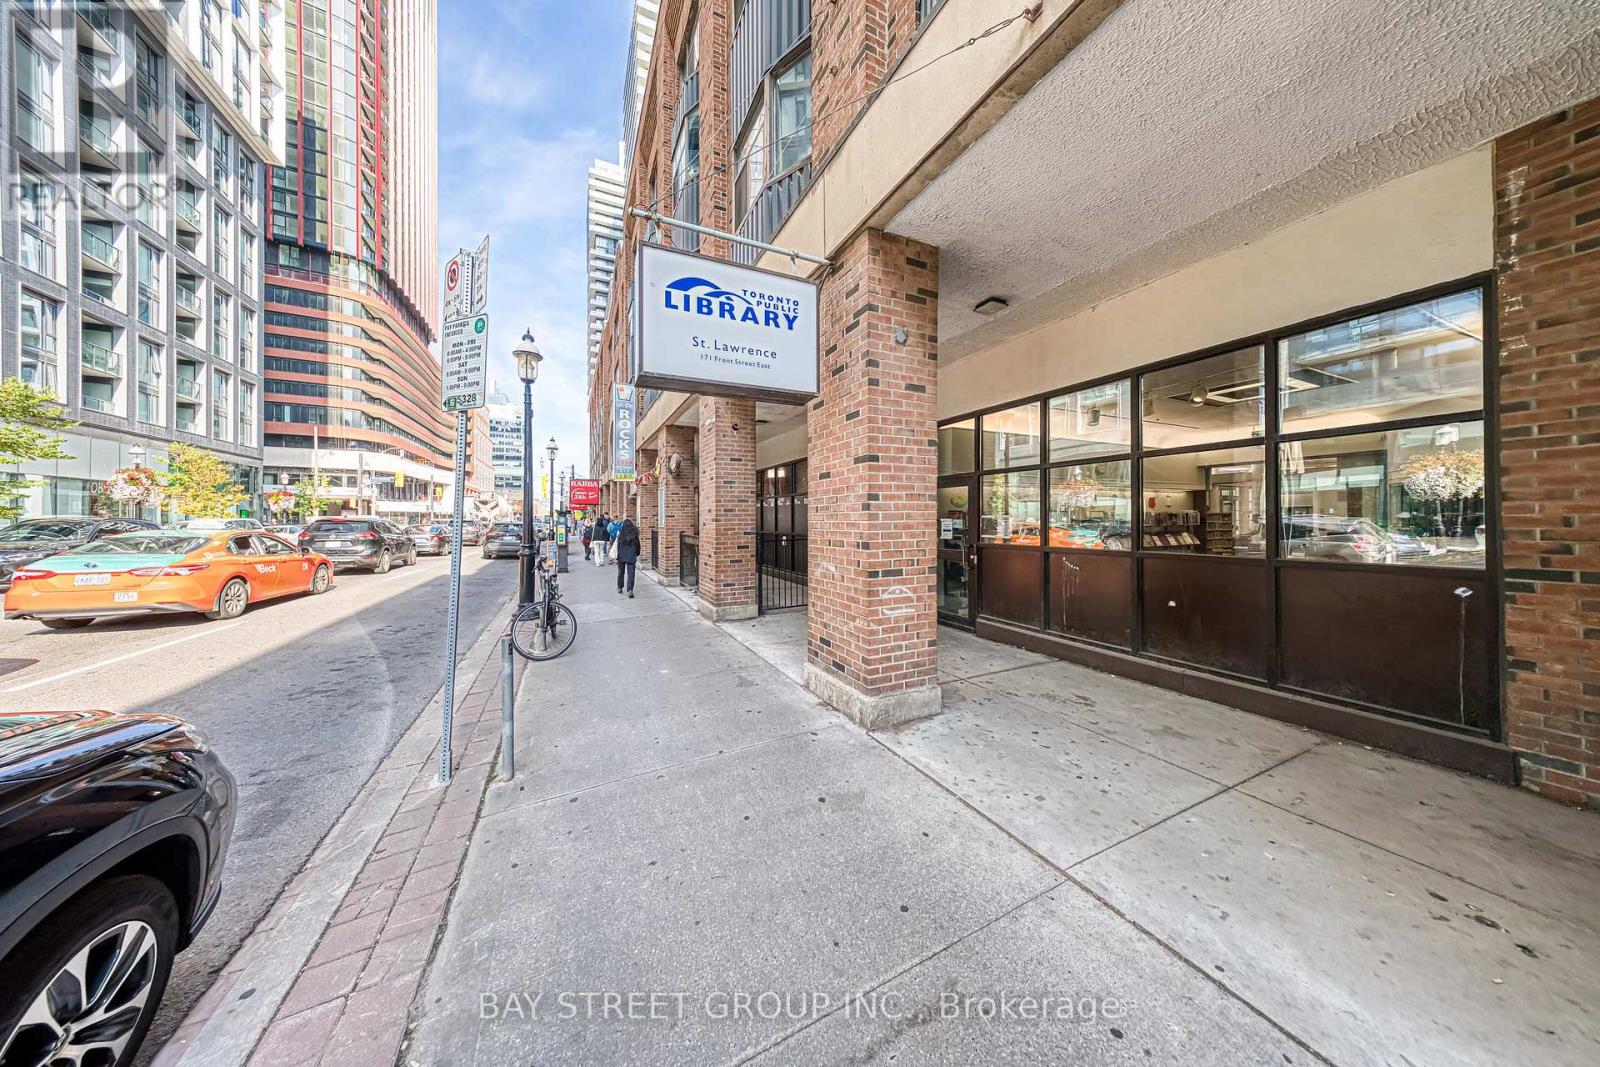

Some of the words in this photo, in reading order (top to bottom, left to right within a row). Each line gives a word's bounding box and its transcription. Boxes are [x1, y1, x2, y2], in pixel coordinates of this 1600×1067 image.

[741, 289, 800, 307] TORONTO
[664, 289, 799, 331] LIBRARY
[756, 300, 799, 314] PUBLIC
[452, 341, 464, 349] MON
[467, 338, 476, 346] FRI
[692, 336, 710, 349] St.
[714, 339, 777, 359] Lawrence
[457, 361, 468, 369] SAT
[700, 353, 712, 361] 171
[714, 355, 734, 365] Front
[734, 358, 755, 367] Street
[756, 362, 771, 370] East
[457, 393, 477, 404] 5328
[618, 409, 631, 459] ROCKS
[255, 563, 277, 573] Beck
